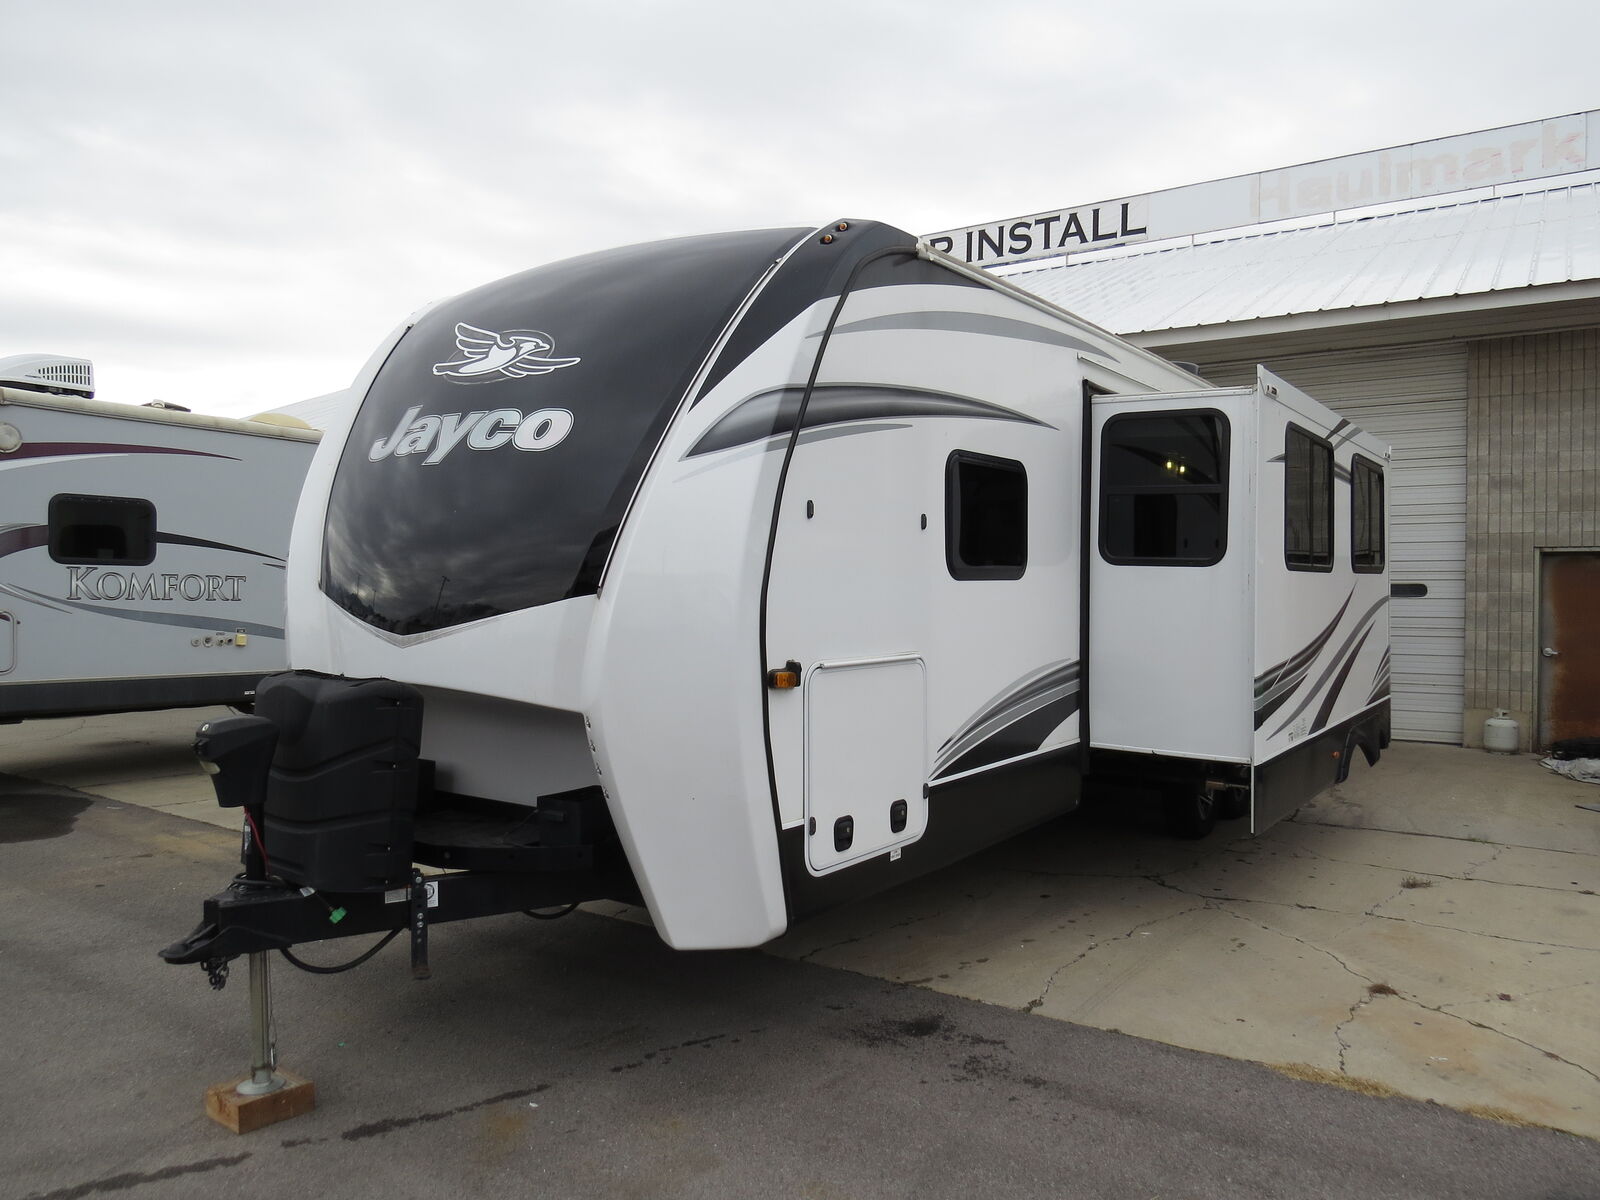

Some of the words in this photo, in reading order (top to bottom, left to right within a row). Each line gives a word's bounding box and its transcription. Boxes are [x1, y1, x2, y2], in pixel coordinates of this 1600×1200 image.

[1249, 122, 1585, 219] Haulmark
[965, 202, 1147, 263] INSTALL
[368, 404, 574, 465] Jayco
[66, 566, 247, 601] KOMFORT
